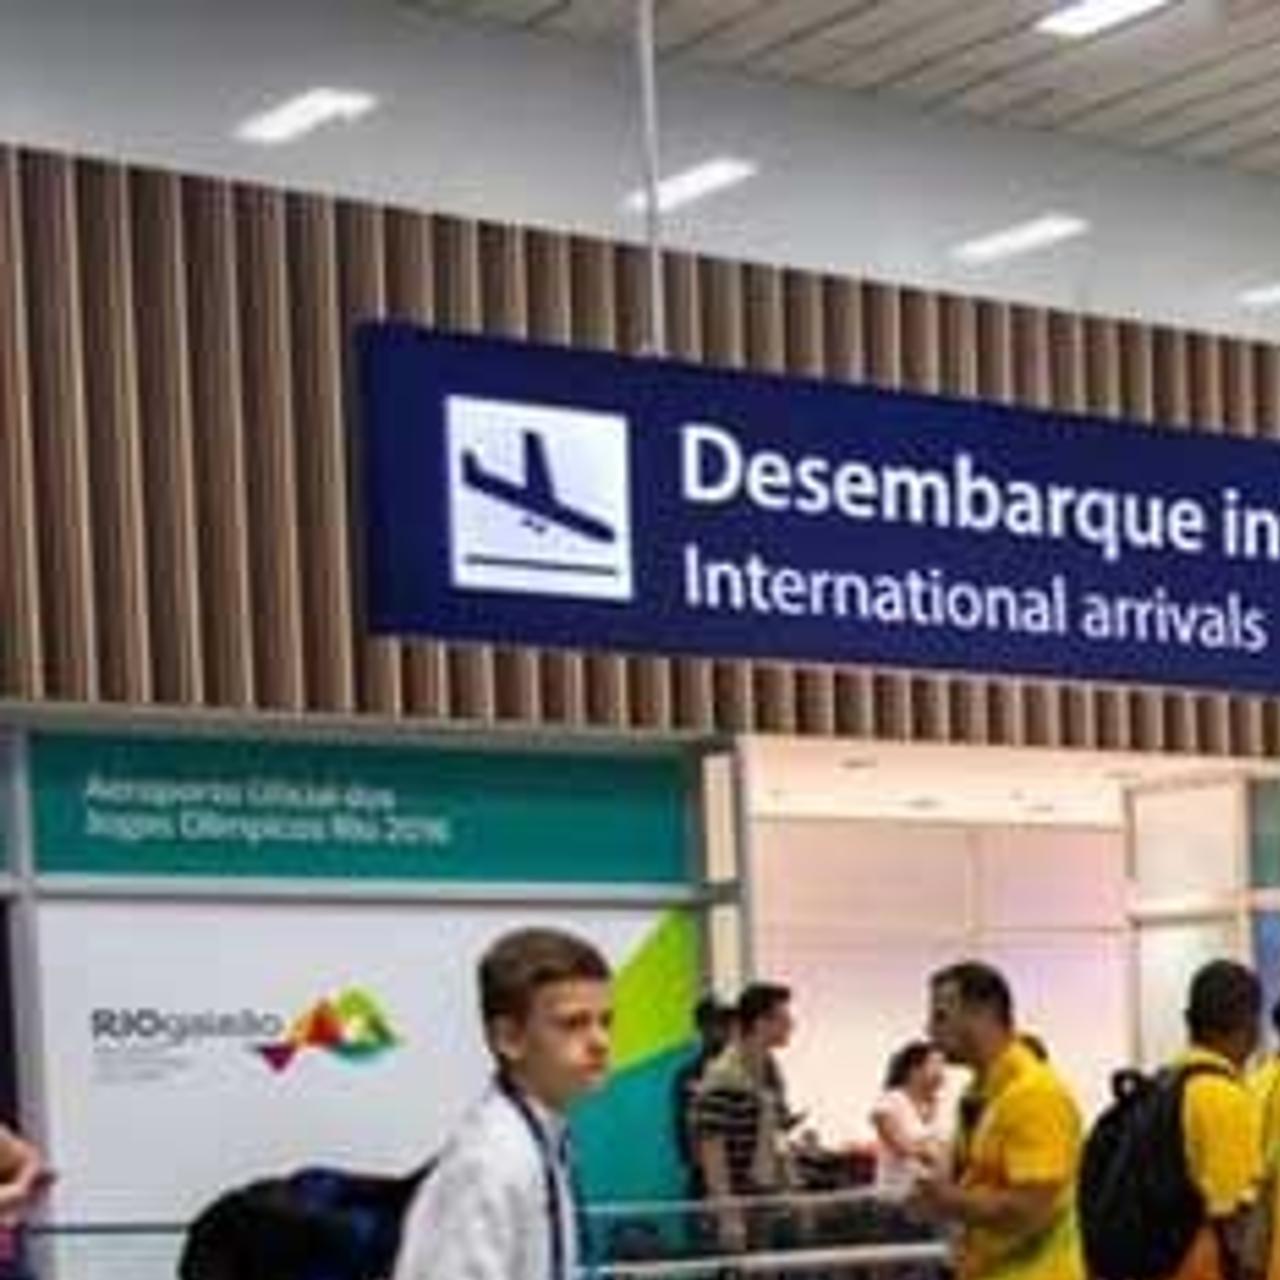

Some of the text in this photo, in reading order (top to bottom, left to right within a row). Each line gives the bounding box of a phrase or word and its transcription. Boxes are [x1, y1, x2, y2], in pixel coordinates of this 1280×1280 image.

[681, 422, 1205, 561] Desembarque
[684, 543, 1269, 652] International arrivals
